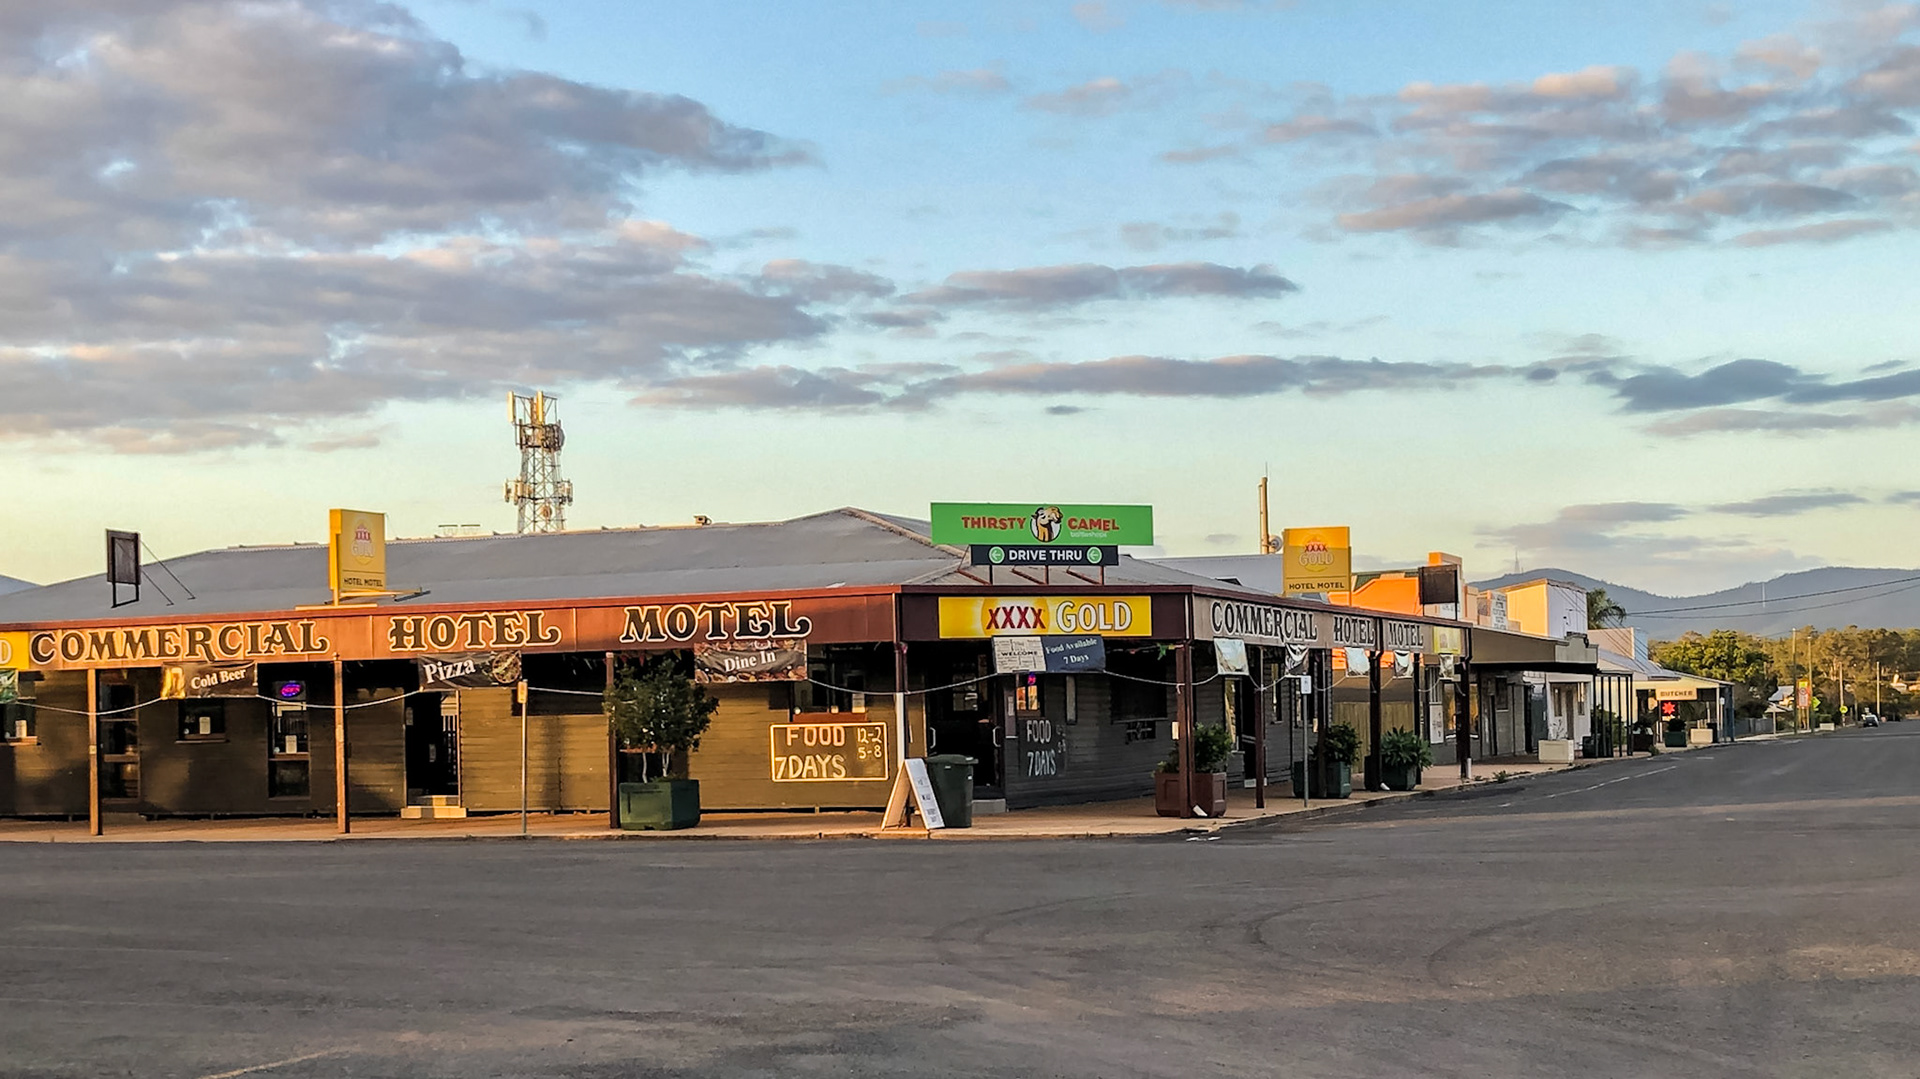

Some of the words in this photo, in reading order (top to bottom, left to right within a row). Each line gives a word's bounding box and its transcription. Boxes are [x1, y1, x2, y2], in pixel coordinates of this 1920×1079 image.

[961, 517, 1027, 531] THIRSTY
[1067, 517, 1120, 531] CAMEL
[1008, 550, 1047, 561] DRIVE
[1049, 550, 1083, 561] THRU
[1304, 544, 1328, 552] XXXX
[1298, 552, 1334, 566] GOLD
[344, 578, 363, 586] HOTEL
[364, 578, 383, 587] MOTEL
[1288, 582, 1316, 590] HOTEL
[1317, 581, 1345, 589] MOTEL
[986, 606, 1046, 630] XXXX
[1056, 600, 1133, 633] GOLD
[1211, 601, 1318, 644] COMMERCIAL
[1333, 615, 1376, 647] HOTEL
[1388, 621, 1424, 648] MOTEL
[29, 620, 330, 665] COMMERCIAL
[388, 610, 562, 652] HOTEL
[619, 600, 813, 643] MOTEL
[1046, 644, 1065, 655] Food
[1066, 638, 1098, 651] Available
[724, 655, 757, 673] Dine
[760, 651, 776, 665] In
[1063, 656, 1069, 664] 7
[1070, 654, 1090, 663] Days
[191, 674, 219, 690] Cold
[219, 668, 247, 684] Beer
[423, 659, 477, 684] Pizza
[786, 726, 845, 747] FOOD
[857, 726, 882, 744] 12-2
[1026, 720, 1052, 744] FOOD
[858, 744, 882, 759] 5-8
